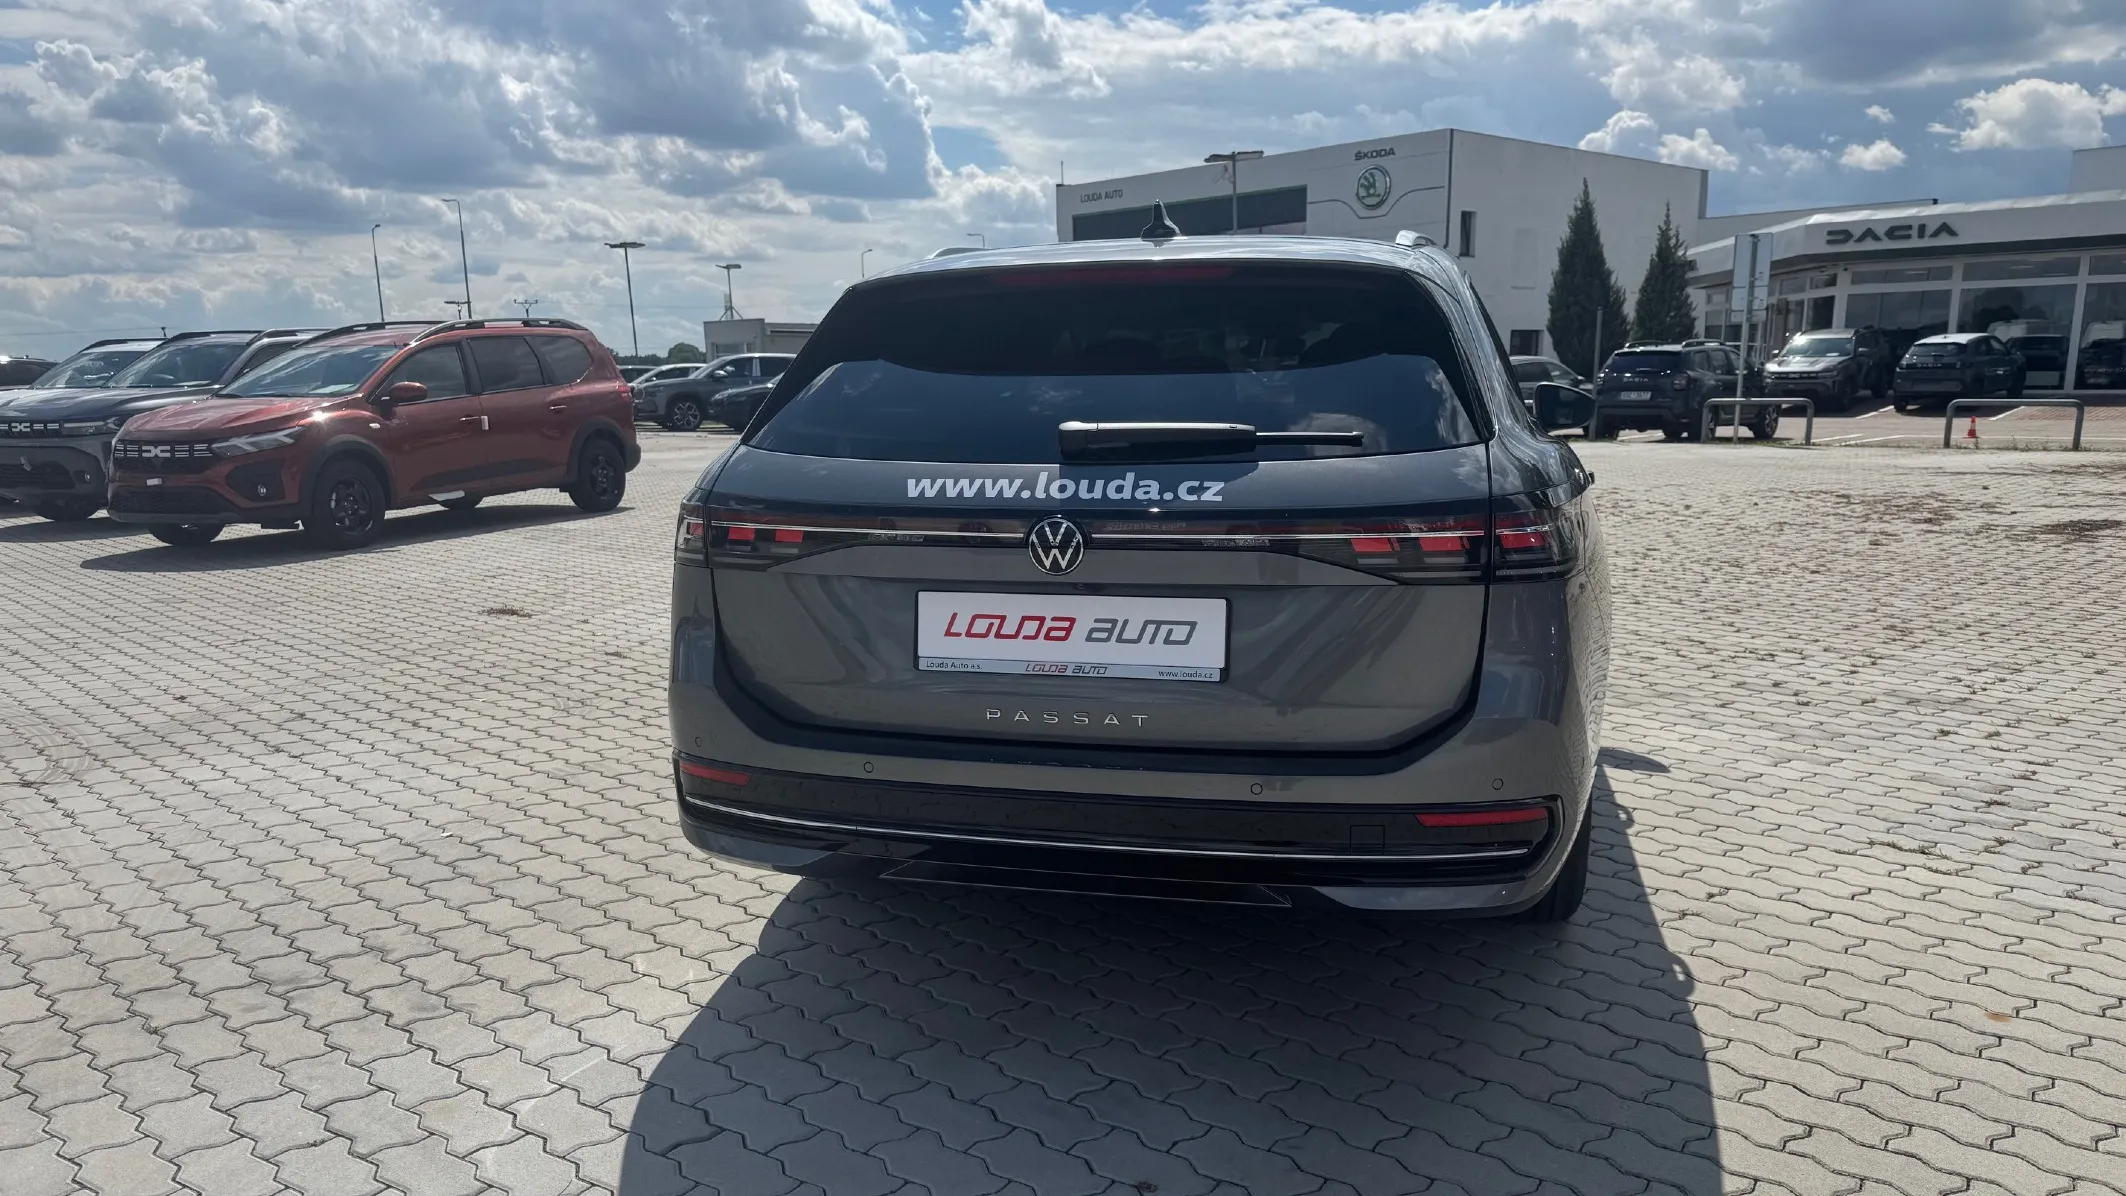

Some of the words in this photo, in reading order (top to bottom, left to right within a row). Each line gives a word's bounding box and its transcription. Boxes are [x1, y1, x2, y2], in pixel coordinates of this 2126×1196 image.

[1354, 148, 1396, 161] ŠKODA
[1080, 191, 1102, 203] LOUDA
[1104, 189, 1124, 200] AUTO
[1826, 221, 1959, 245] DACIA
[906, 471, 1225, 502] www.louda.cz
[943, 612, 1077, 642] LOUDA
[1084, 617, 1198, 646] AUTO
[926, 660, 948, 669] Louda
[950, 661, 969, 670] Auto
[970, 662, 983, 671] a.s.
[1158, 669, 1213, 679] www.louda.cz
[986, 708, 1149, 727] PASSAT
